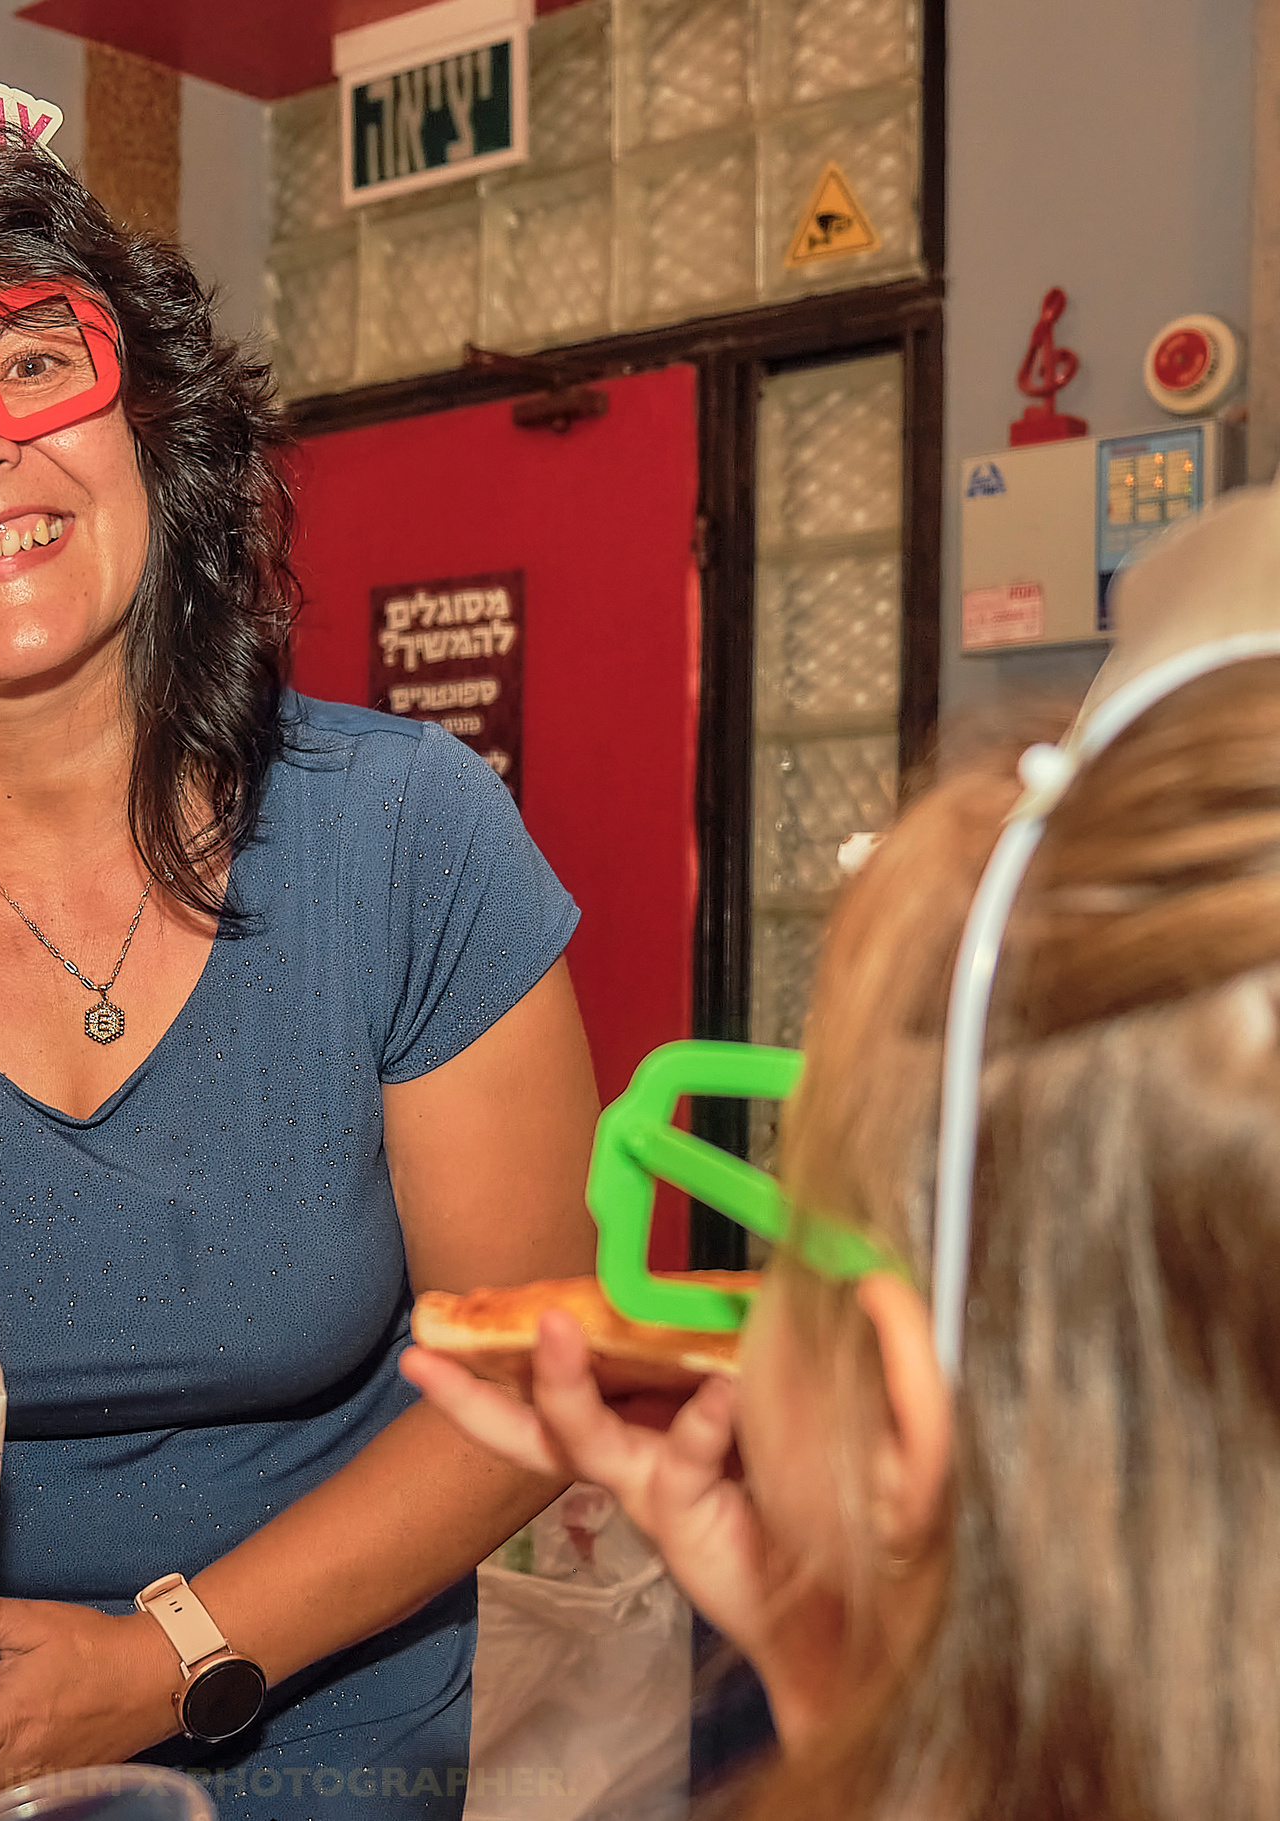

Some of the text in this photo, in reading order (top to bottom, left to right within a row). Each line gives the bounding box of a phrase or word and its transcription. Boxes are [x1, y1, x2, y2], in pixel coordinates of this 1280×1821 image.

[365, 48, 492, 186] יציאה
[385, 587, 510, 630] מסוגלים
[379, 618, 516, 670] להמשיך?
